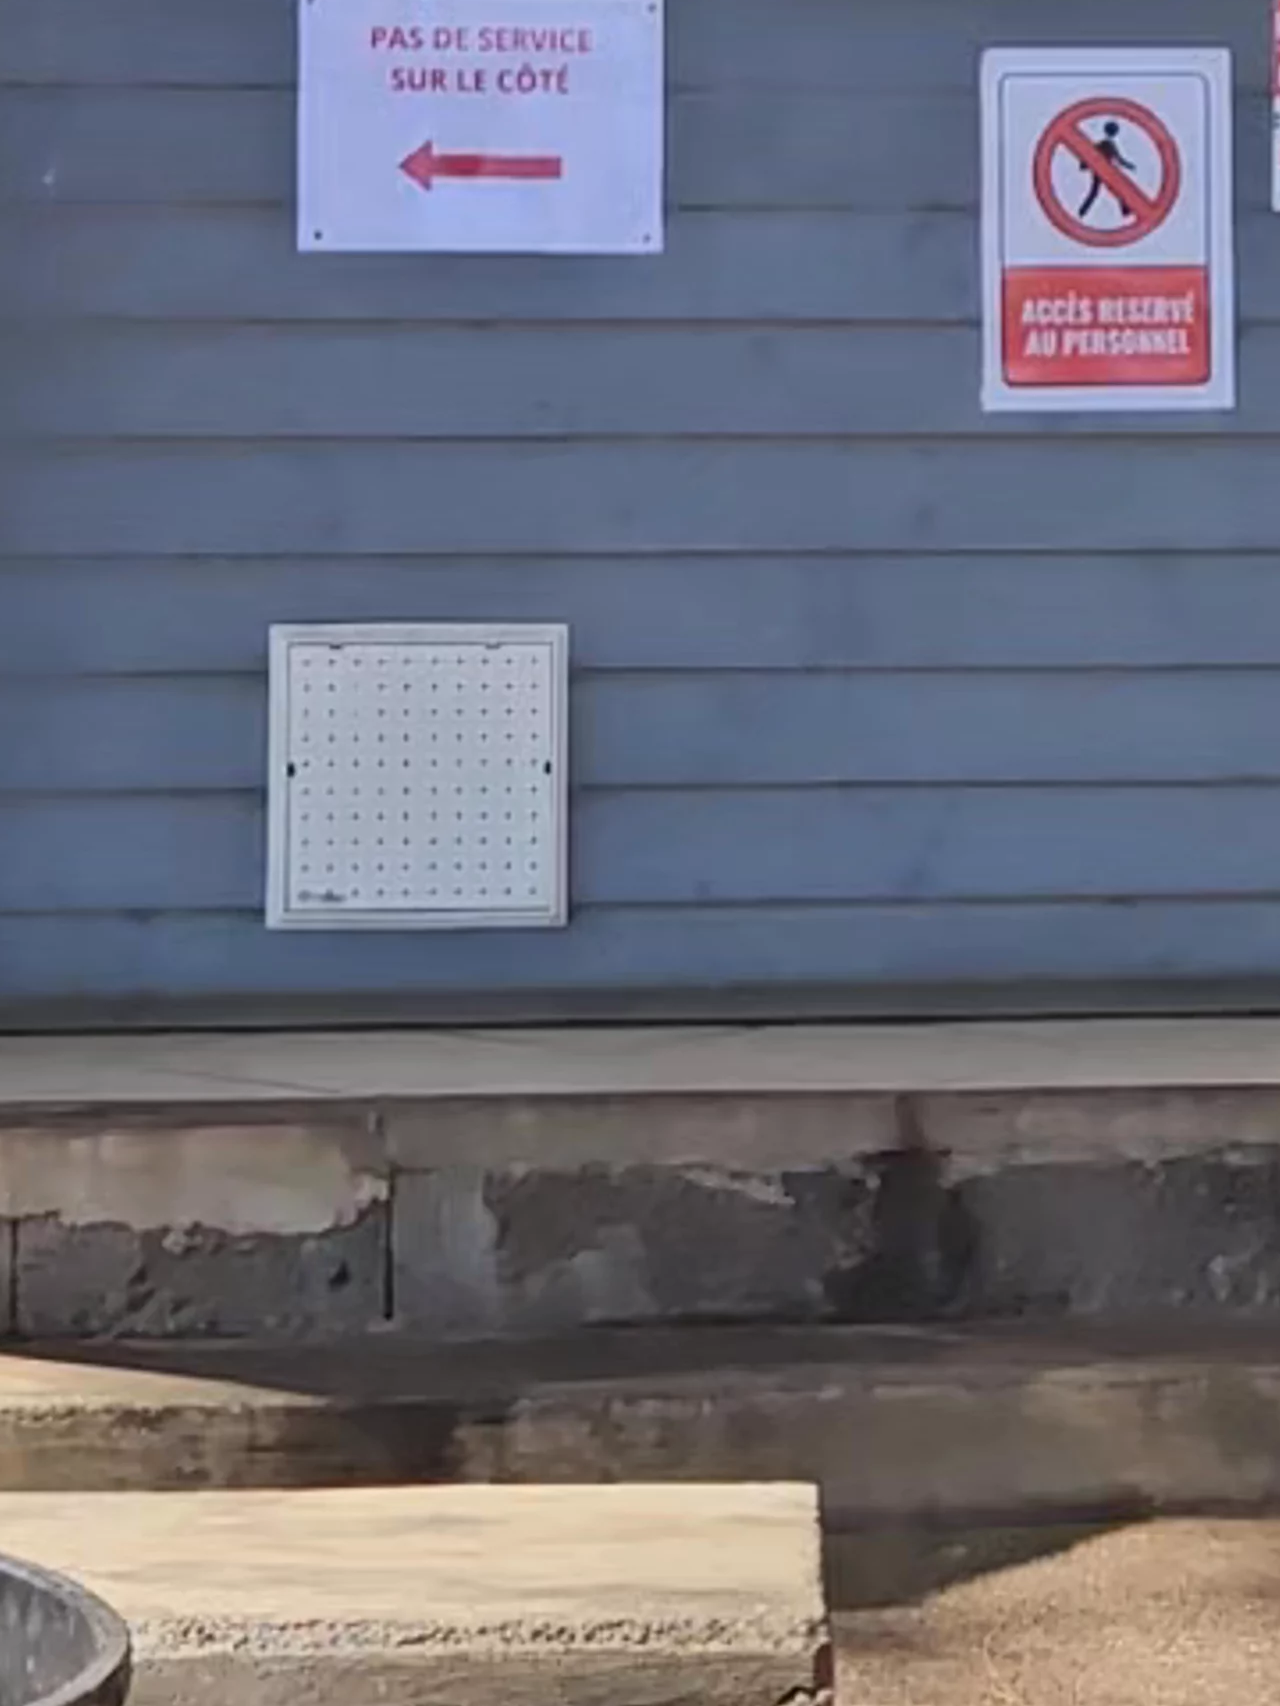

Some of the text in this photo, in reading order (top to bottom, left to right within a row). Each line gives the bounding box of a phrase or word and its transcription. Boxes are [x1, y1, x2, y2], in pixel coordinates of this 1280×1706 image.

[370, 25, 593, 53] PAS DE SERVICE
[391, 62, 570, 95] SUR LE CÔTÉ
[1024, 328, 1191, 357] AU PERSONNEL
